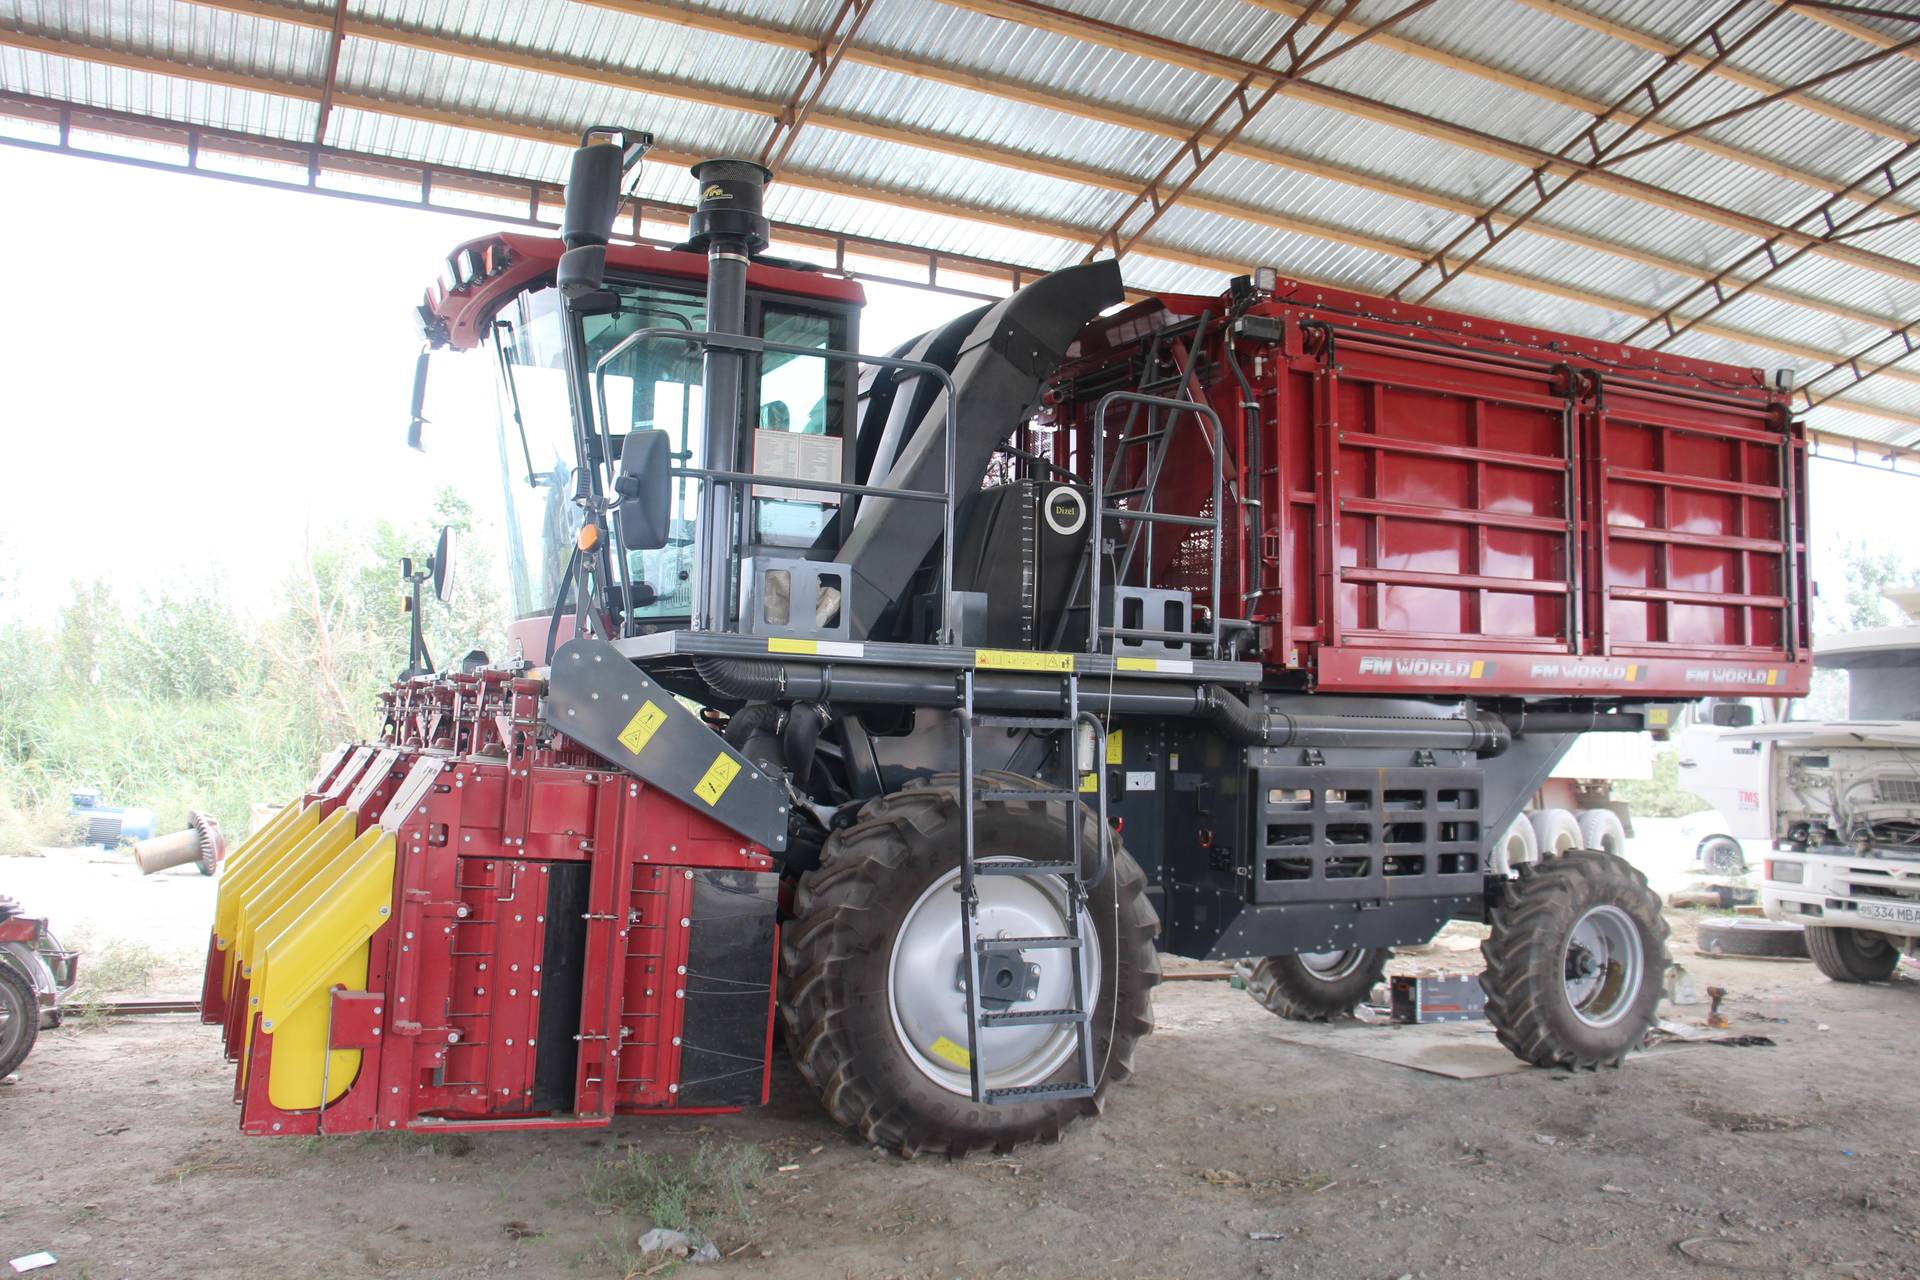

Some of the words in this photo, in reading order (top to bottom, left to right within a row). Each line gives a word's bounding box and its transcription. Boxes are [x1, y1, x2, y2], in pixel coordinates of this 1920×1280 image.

[1056, 506, 1075, 516] Dizel
[1359, 656, 1392, 676] FM
[1395, 657, 1470, 678] WORLD
[1531, 663, 1560, 679] FM
[1563, 664, 1625, 680] WORLD
[1685, 669, 1710, 681] FM
[1712, 669, 1767, 684] WORLD
[1873, 905, 1895, 919] 334
